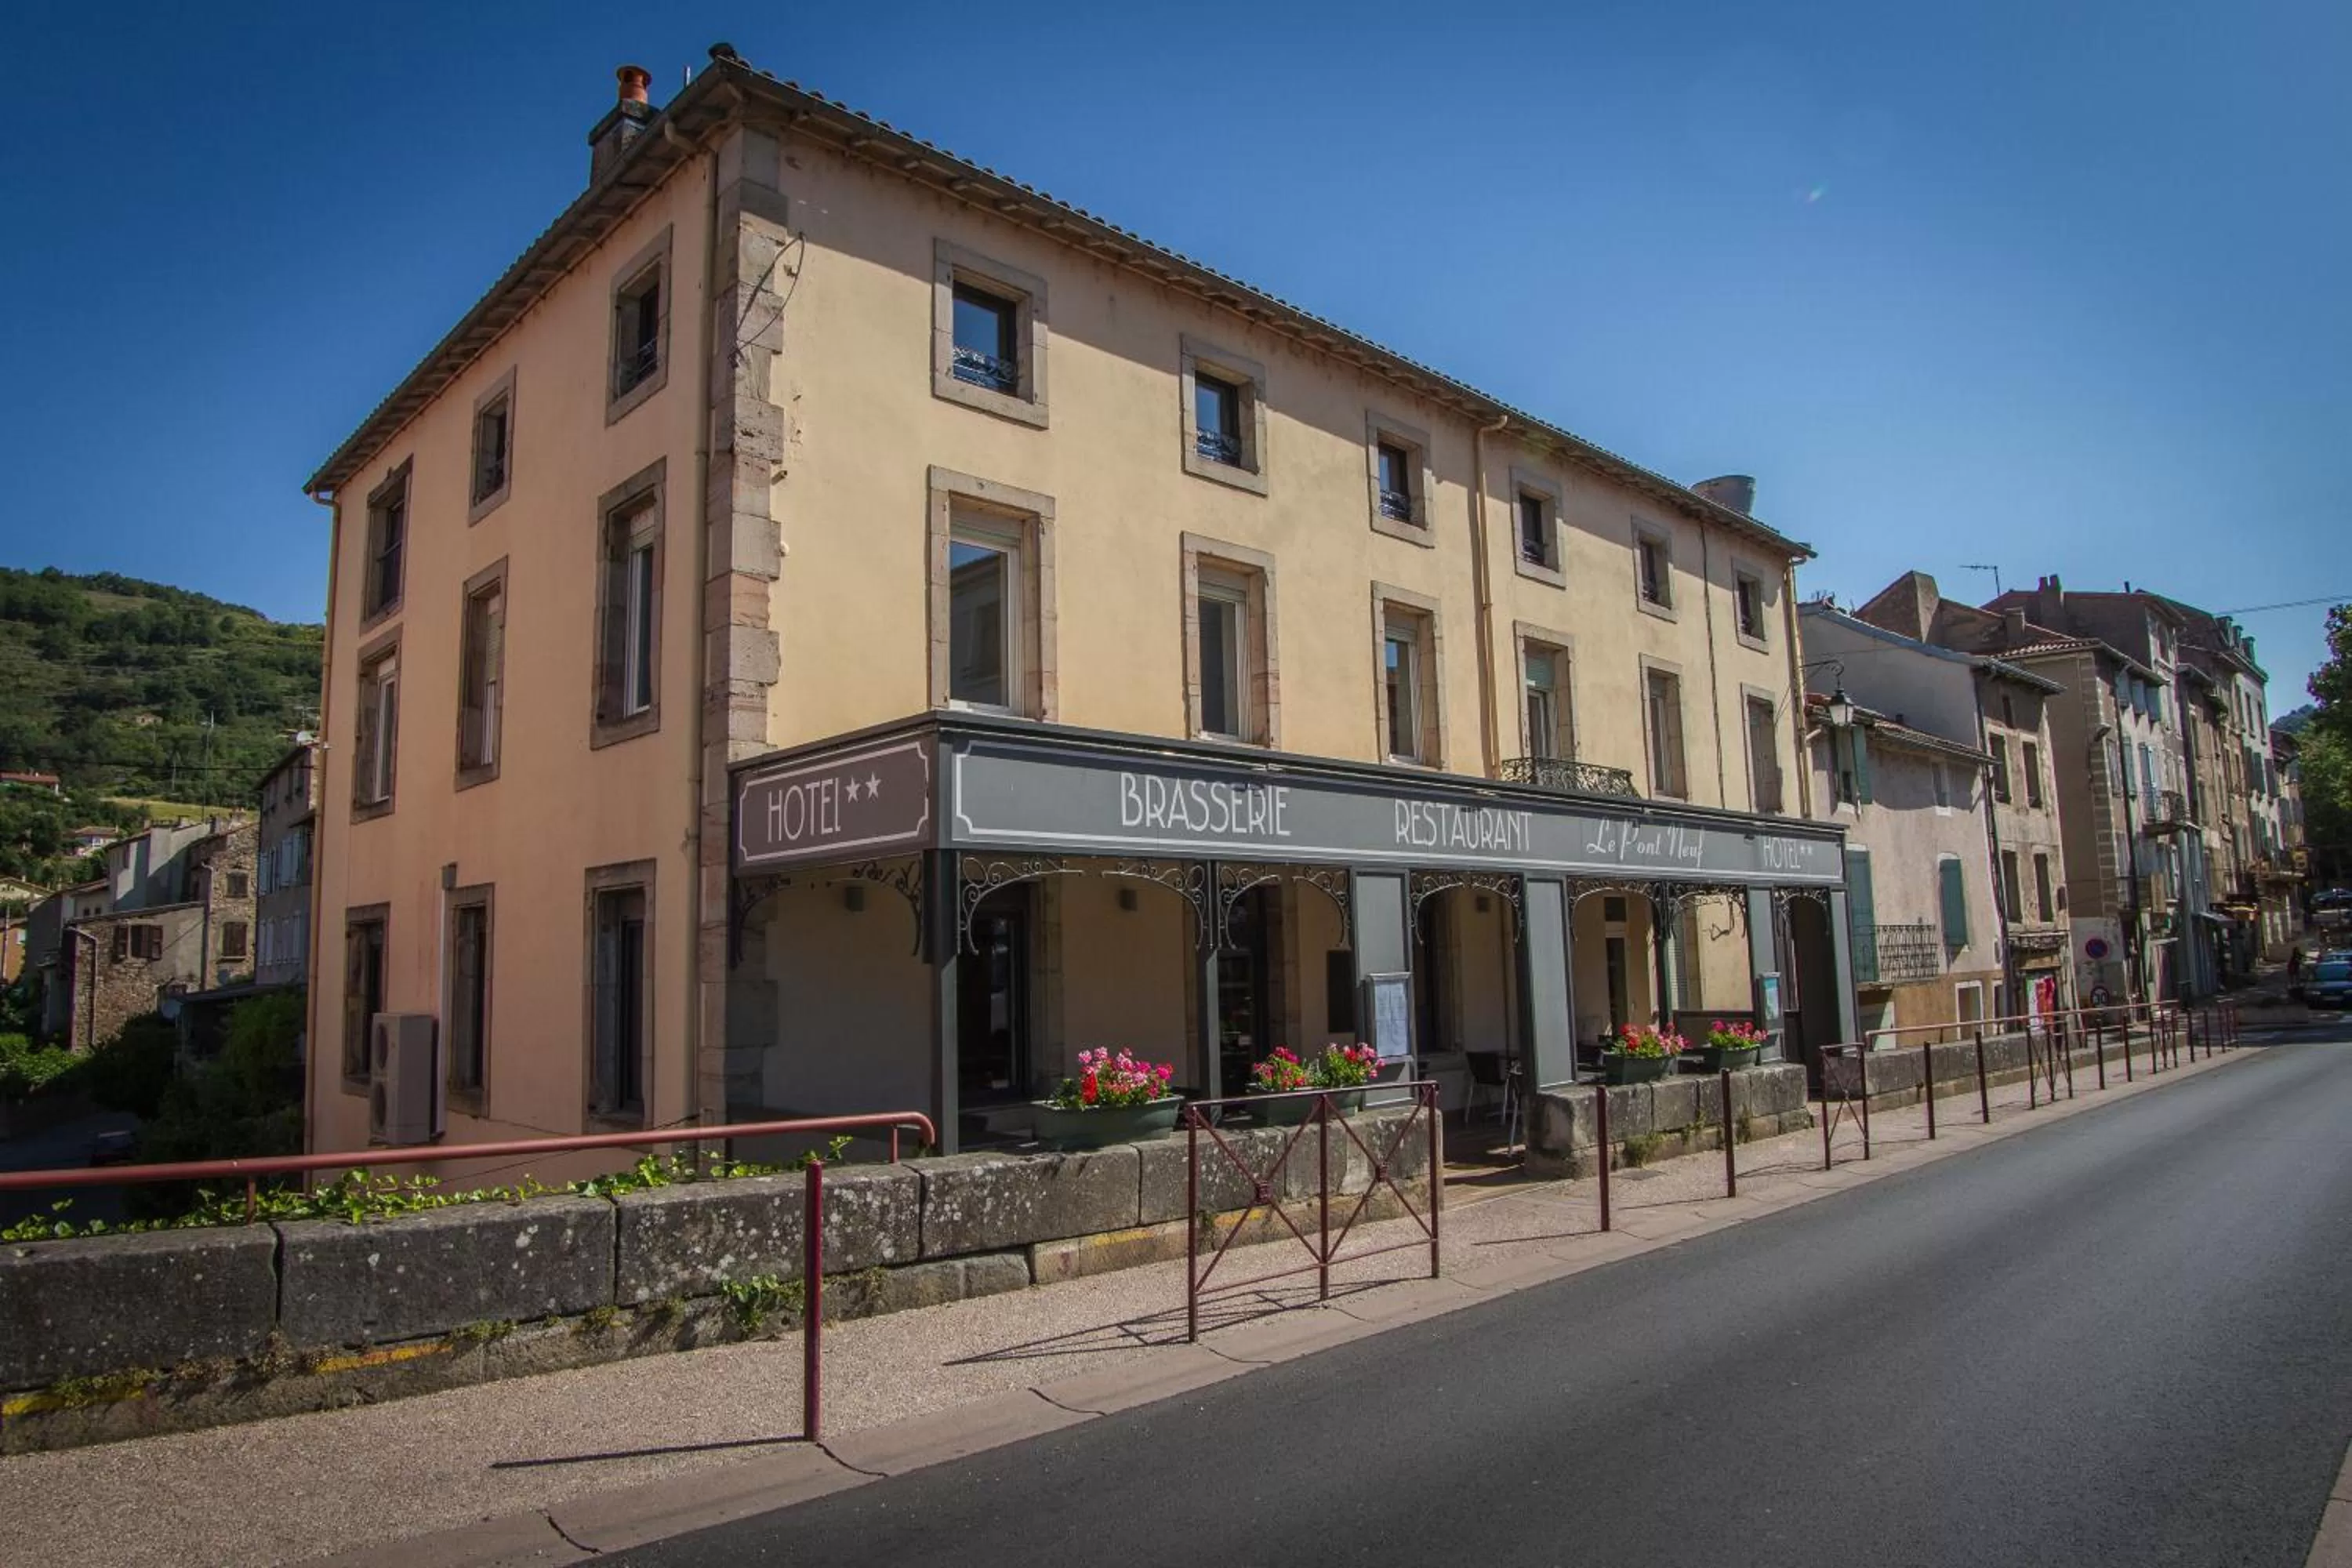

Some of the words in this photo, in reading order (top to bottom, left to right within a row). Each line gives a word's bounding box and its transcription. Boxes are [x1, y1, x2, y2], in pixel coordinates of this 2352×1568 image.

[768, 777, 841, 843] HOTEL
[1120, 771, 1291, 837] BRASSERIE
[1395, 798, 1533, 852] RESTAURANT
[1586, 816, 1616, 854] Le
[1619, 819, 1661, 862] Pont
[1667, 825, 1704, 869] Neuf
[1762, 836, 1801, 869] HOTEL
